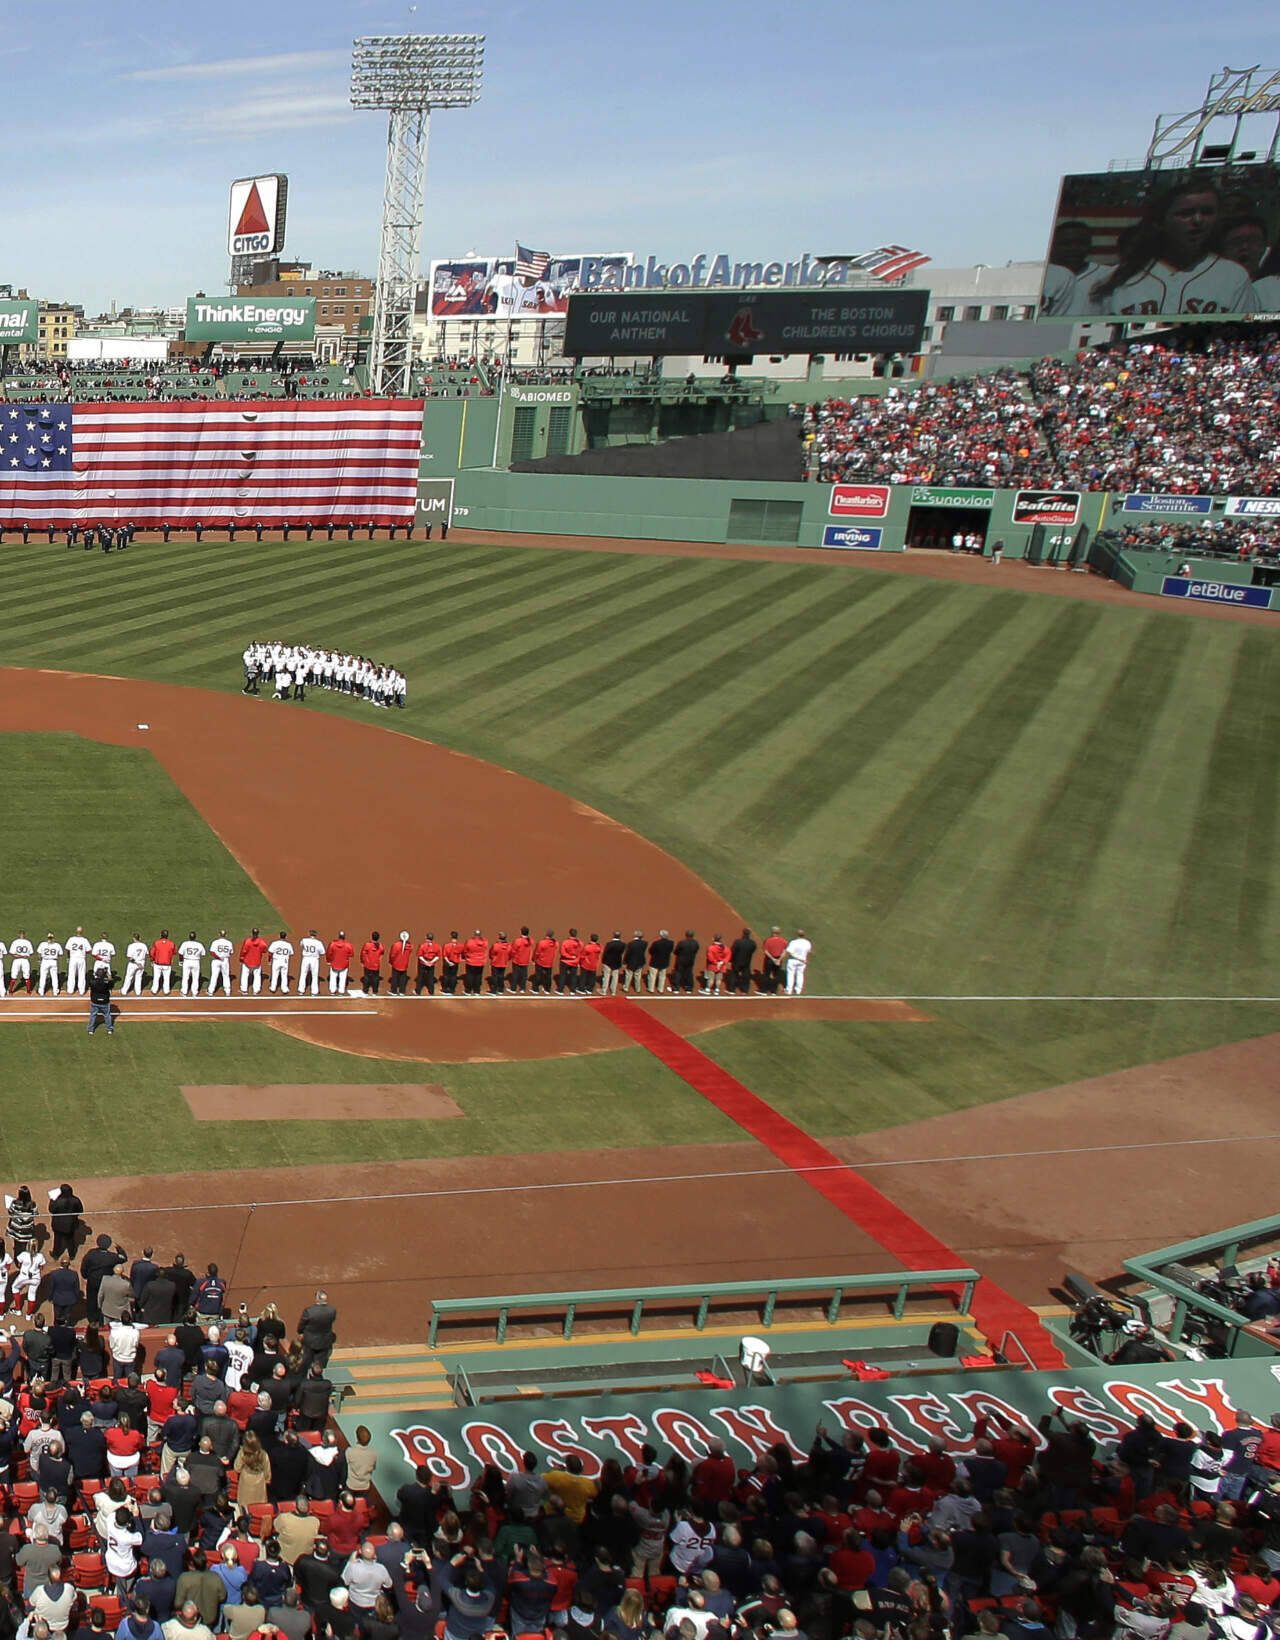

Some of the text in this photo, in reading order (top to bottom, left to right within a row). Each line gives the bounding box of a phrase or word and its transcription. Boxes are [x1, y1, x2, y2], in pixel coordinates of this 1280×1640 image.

[233, 234, 269, 252] CITGO
[579, 253, 849, 288] Bank of America
[590, 309, 689, 323] OUR NATIONAL
[811, 307, 894, 320] THE BOSTON
[610, 327, 667, 340] ANTHEM
[782, 324, 916, 338] CHILDREN'S CHORUS
[520, 392, 572, 402] ABIOMED
[928, 494, 993, 506] sunovion
[1016, 500, 1078, 513] Safelite
[1140, 501, 1199, 512] Scientific
[1149, 495, 1188, 505] Boston
[454, 508, 469, 516] 379
[1031, 513, 1073, 522] AutoGlass
[834, 532, 870, 542] IRVING
[1185, 581, 1245, 601] jetBlue
[71, 943, 84, 951] 24
[390, 1404, 811, 1491] BOSTON
[822, 1390, 1050, 1458] RED
